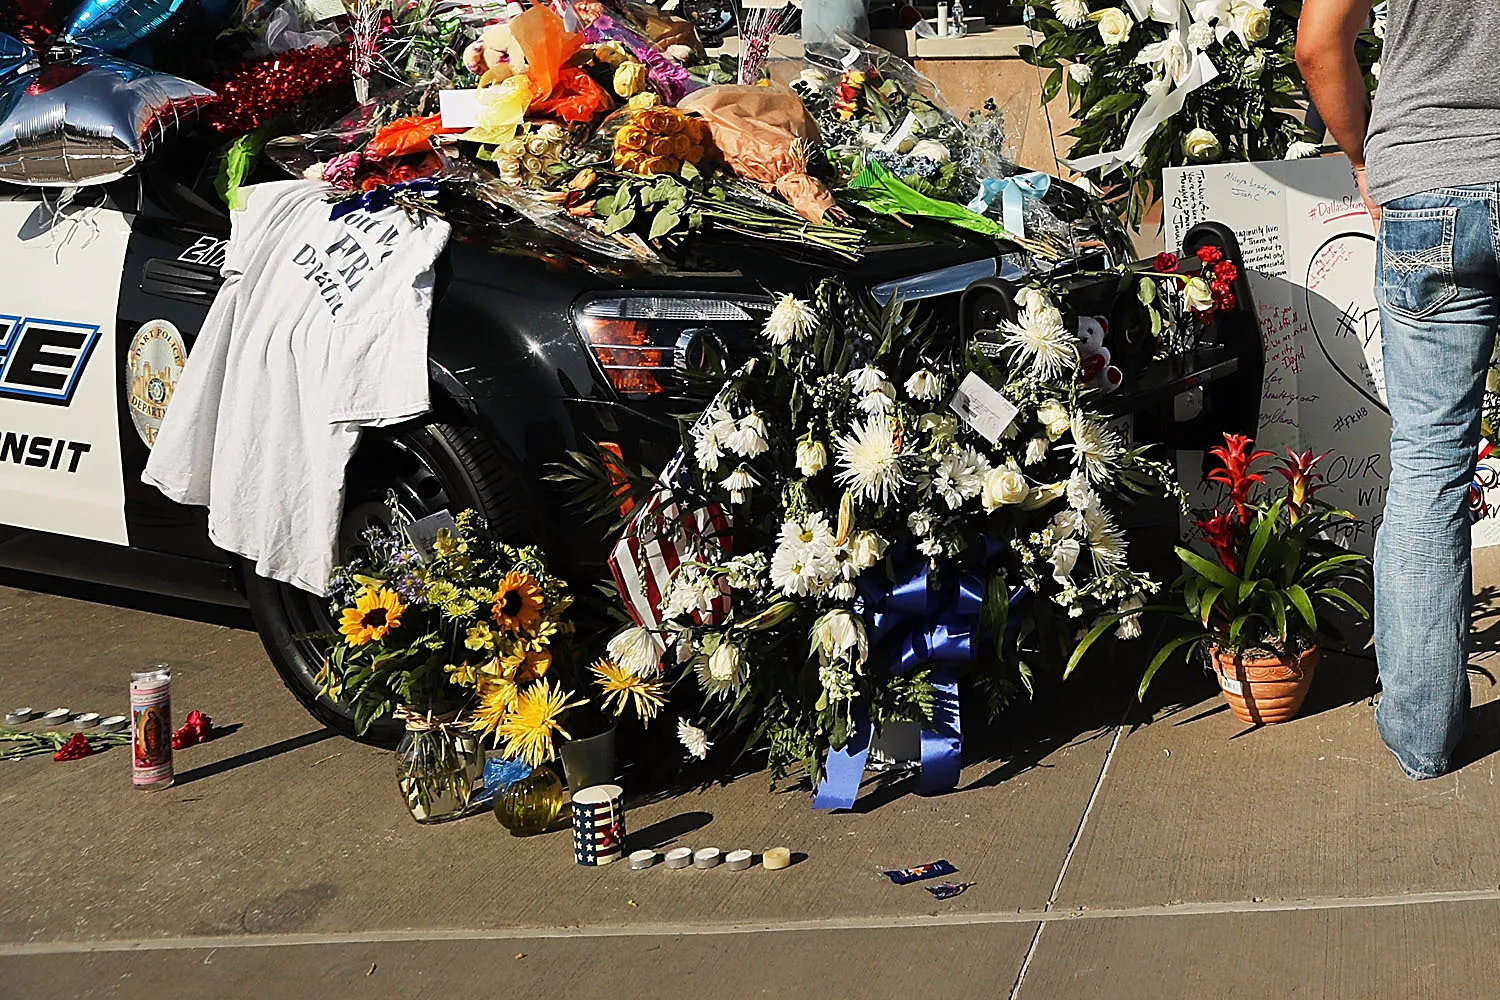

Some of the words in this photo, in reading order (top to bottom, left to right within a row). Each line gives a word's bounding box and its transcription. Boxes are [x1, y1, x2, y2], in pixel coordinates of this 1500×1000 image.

[135, 330, 155, 358] DART
[157, 328, 182, 364] POLICE
[1326, 453, 1384, 485] OUR
